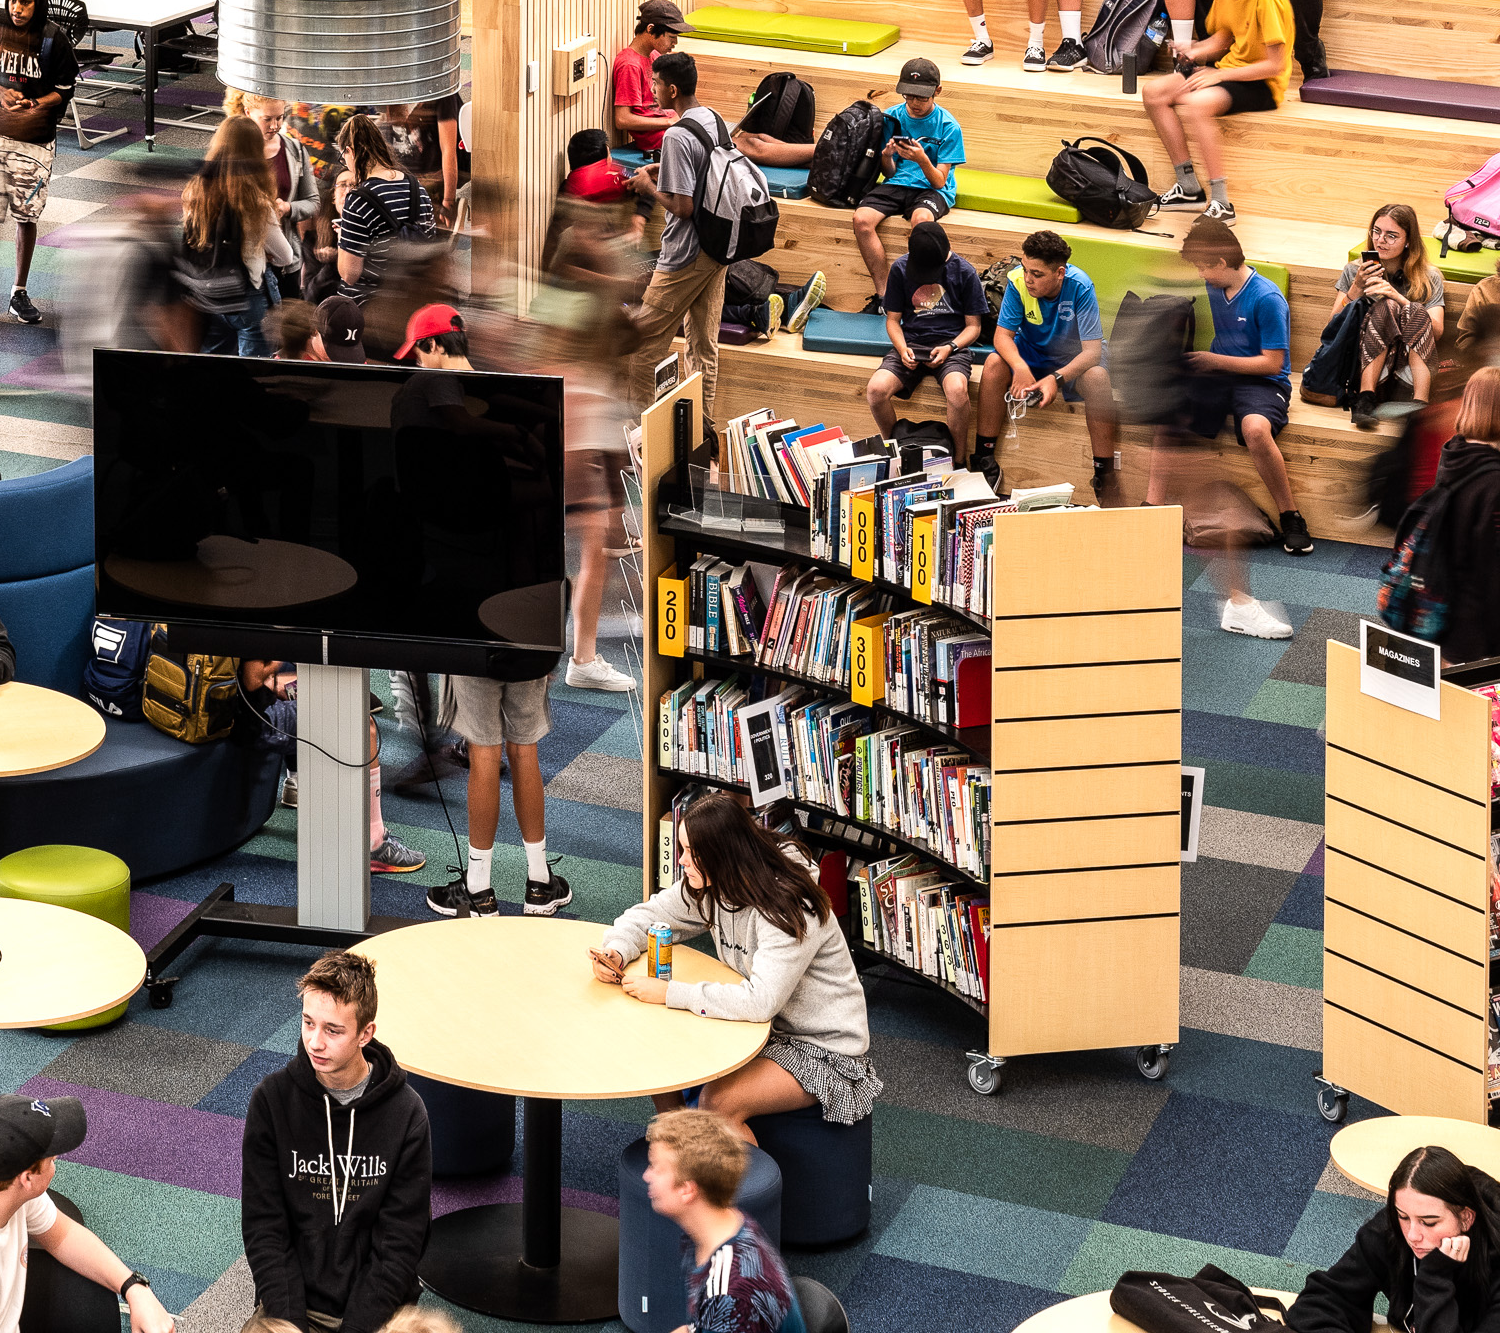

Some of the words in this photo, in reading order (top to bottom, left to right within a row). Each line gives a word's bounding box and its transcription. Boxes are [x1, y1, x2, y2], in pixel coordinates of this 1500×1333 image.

[858, 511, 867, 563] 000
[917, 534, 926, 585] 100
[665, 590, 677, 640] 200
[708, 582, 718, 619] BIBLE
[930, 627, 957, 638] NATURAL
[857, 636, 866, 688] 300
[961, 650, 973, 658] The
[1378, 645, 1421, 669] MAGAZINES
[662, 714, 670, 752] 306
[764, 773, 773, 781] 320
[861, 888, 869, 927] 360
[940, 924, 952, 966] 363
[288, 1149, 331, 1179] Jack
[336, 1154, 387, 1178] Wills
[312, 1192, 331, 1200] FORE
[344, 1178, 379, 1187] RITAIN
[1149, 1280, 1182, 1303] STOLEN
